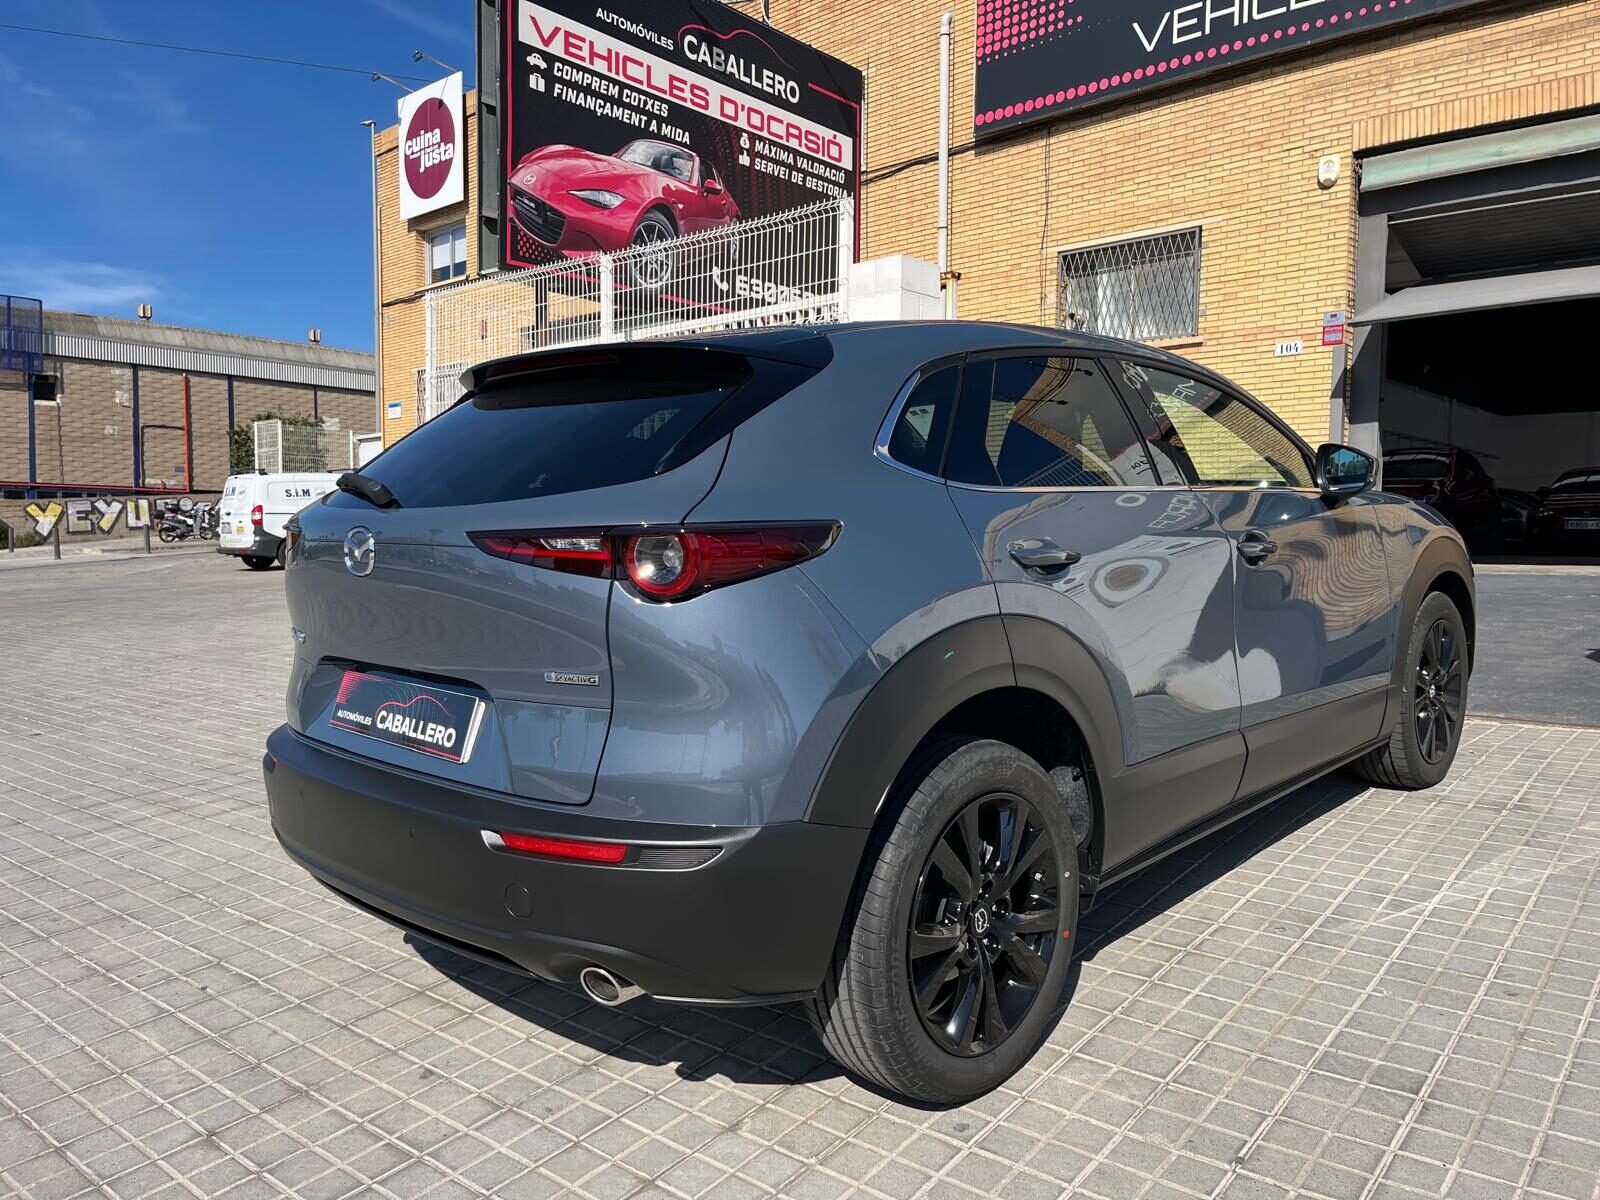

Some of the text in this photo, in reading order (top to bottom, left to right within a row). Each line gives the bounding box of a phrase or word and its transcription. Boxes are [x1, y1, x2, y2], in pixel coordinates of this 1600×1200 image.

[1132, 0, 1326, 52] VEHIC
[596, 7, 800, 104] AUTOMÓVILES CABALLERO
[529, 14, 843, 164] VEHICLES D'OCASIÓ
[553, 61, 669, 118] COMPREM COTXES
[553, 82, 690, 146] FINANÇAMENT A MIDA
[405, 127, 441, 156] cuina
[419, 141, 454, 174] justa
[754, 138, 845, 184] MÀXIMA VALORACIÓ
[754, 157, 848, 199] SERVEI DE GESTORIA
[1279, 342, 1299, 355] 104
[336, 709, 456, 748] AUTOMÓVILES CABALLERO
